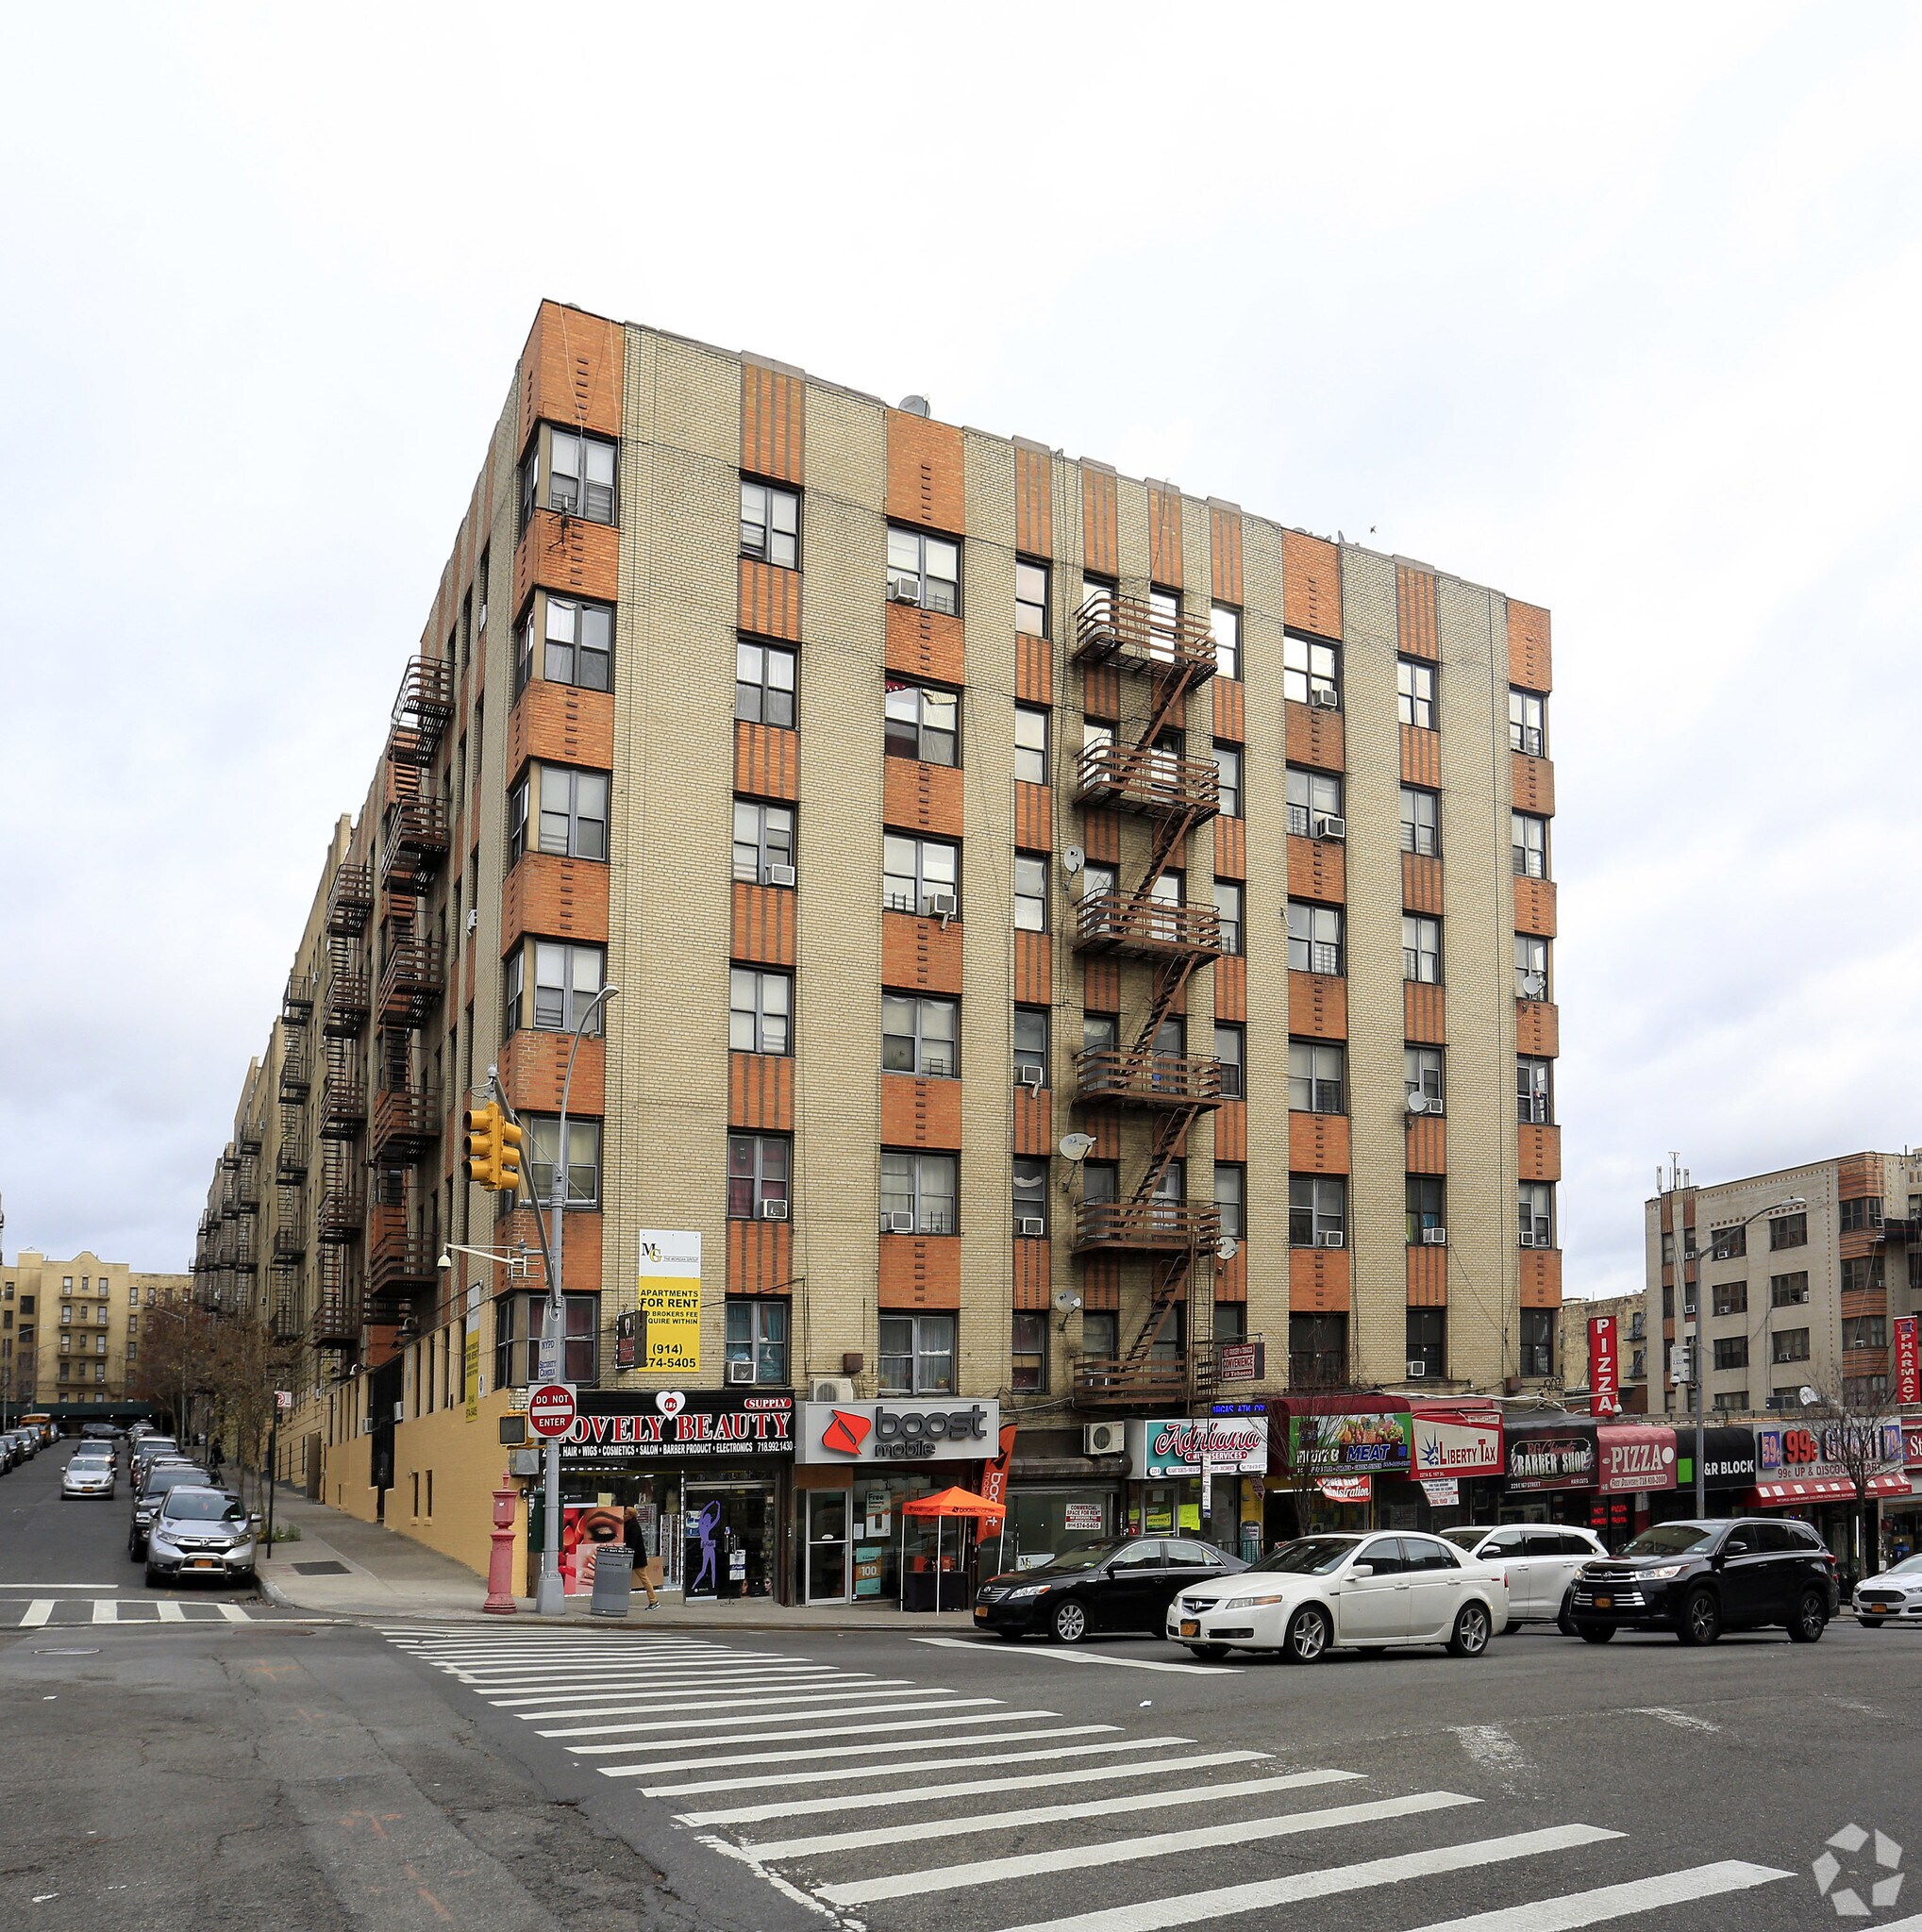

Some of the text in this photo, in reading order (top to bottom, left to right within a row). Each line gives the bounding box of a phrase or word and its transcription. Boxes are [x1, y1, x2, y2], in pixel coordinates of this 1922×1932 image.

[641, 1289, 699, 1298] APARTMENTS
[641, 1298, 699, 1308] FOR RENT
[541, 1340, 555, 1350] NYPD
[652, 1343, 683, 1355] (914)
[1596, 1318, 1613, 1412] PIZZA
[1900, 1333, 1914, 1402] PHARMACY
[536, 1395, 569, 1405] DO NOT
[665, 1398, 787, 1409] LBS SUPPLY
[539, 1418, 566, 1427] ENTER
[559, 1412, 792, 1443] OVELY BEAUTY
[876, 1405, 988, 1440] boost
[1156, 1423, 1262, 1457] Adriana
[562, 1445, 577, 1457] HAIR
[582, 1445, 598, 1457] WIGS
[602, 1444, 635, 1457] COSMETICS
[639, 1443, 659, 1456] SALON
[662, 1443, 686, 1455] BARBER
[686, 1442, 712, 1454] PRODUCT
[716, 1441, 753, 1453] ELECTRONICS
[757, 1441, 793, 1452] 718.992.1430
[875, 1441, 937, 1457] mobile
[1212, 1451, 1243, 1460] SERVICES
[1346, 1444, 1391, 1461] MEAT
[1439, 1439, 1496, 1465] LIBERTY TAX
[1516, 1451, 1587, 1476] BARBER SHOP
[1611, 1444, 1663, 1474] PIZZA
[1704, 1459, 1754, 1475] &R BLOCK
[1795, 1468, 1806, 1477] UP
[1808, 1467, 1813, 1476] &
